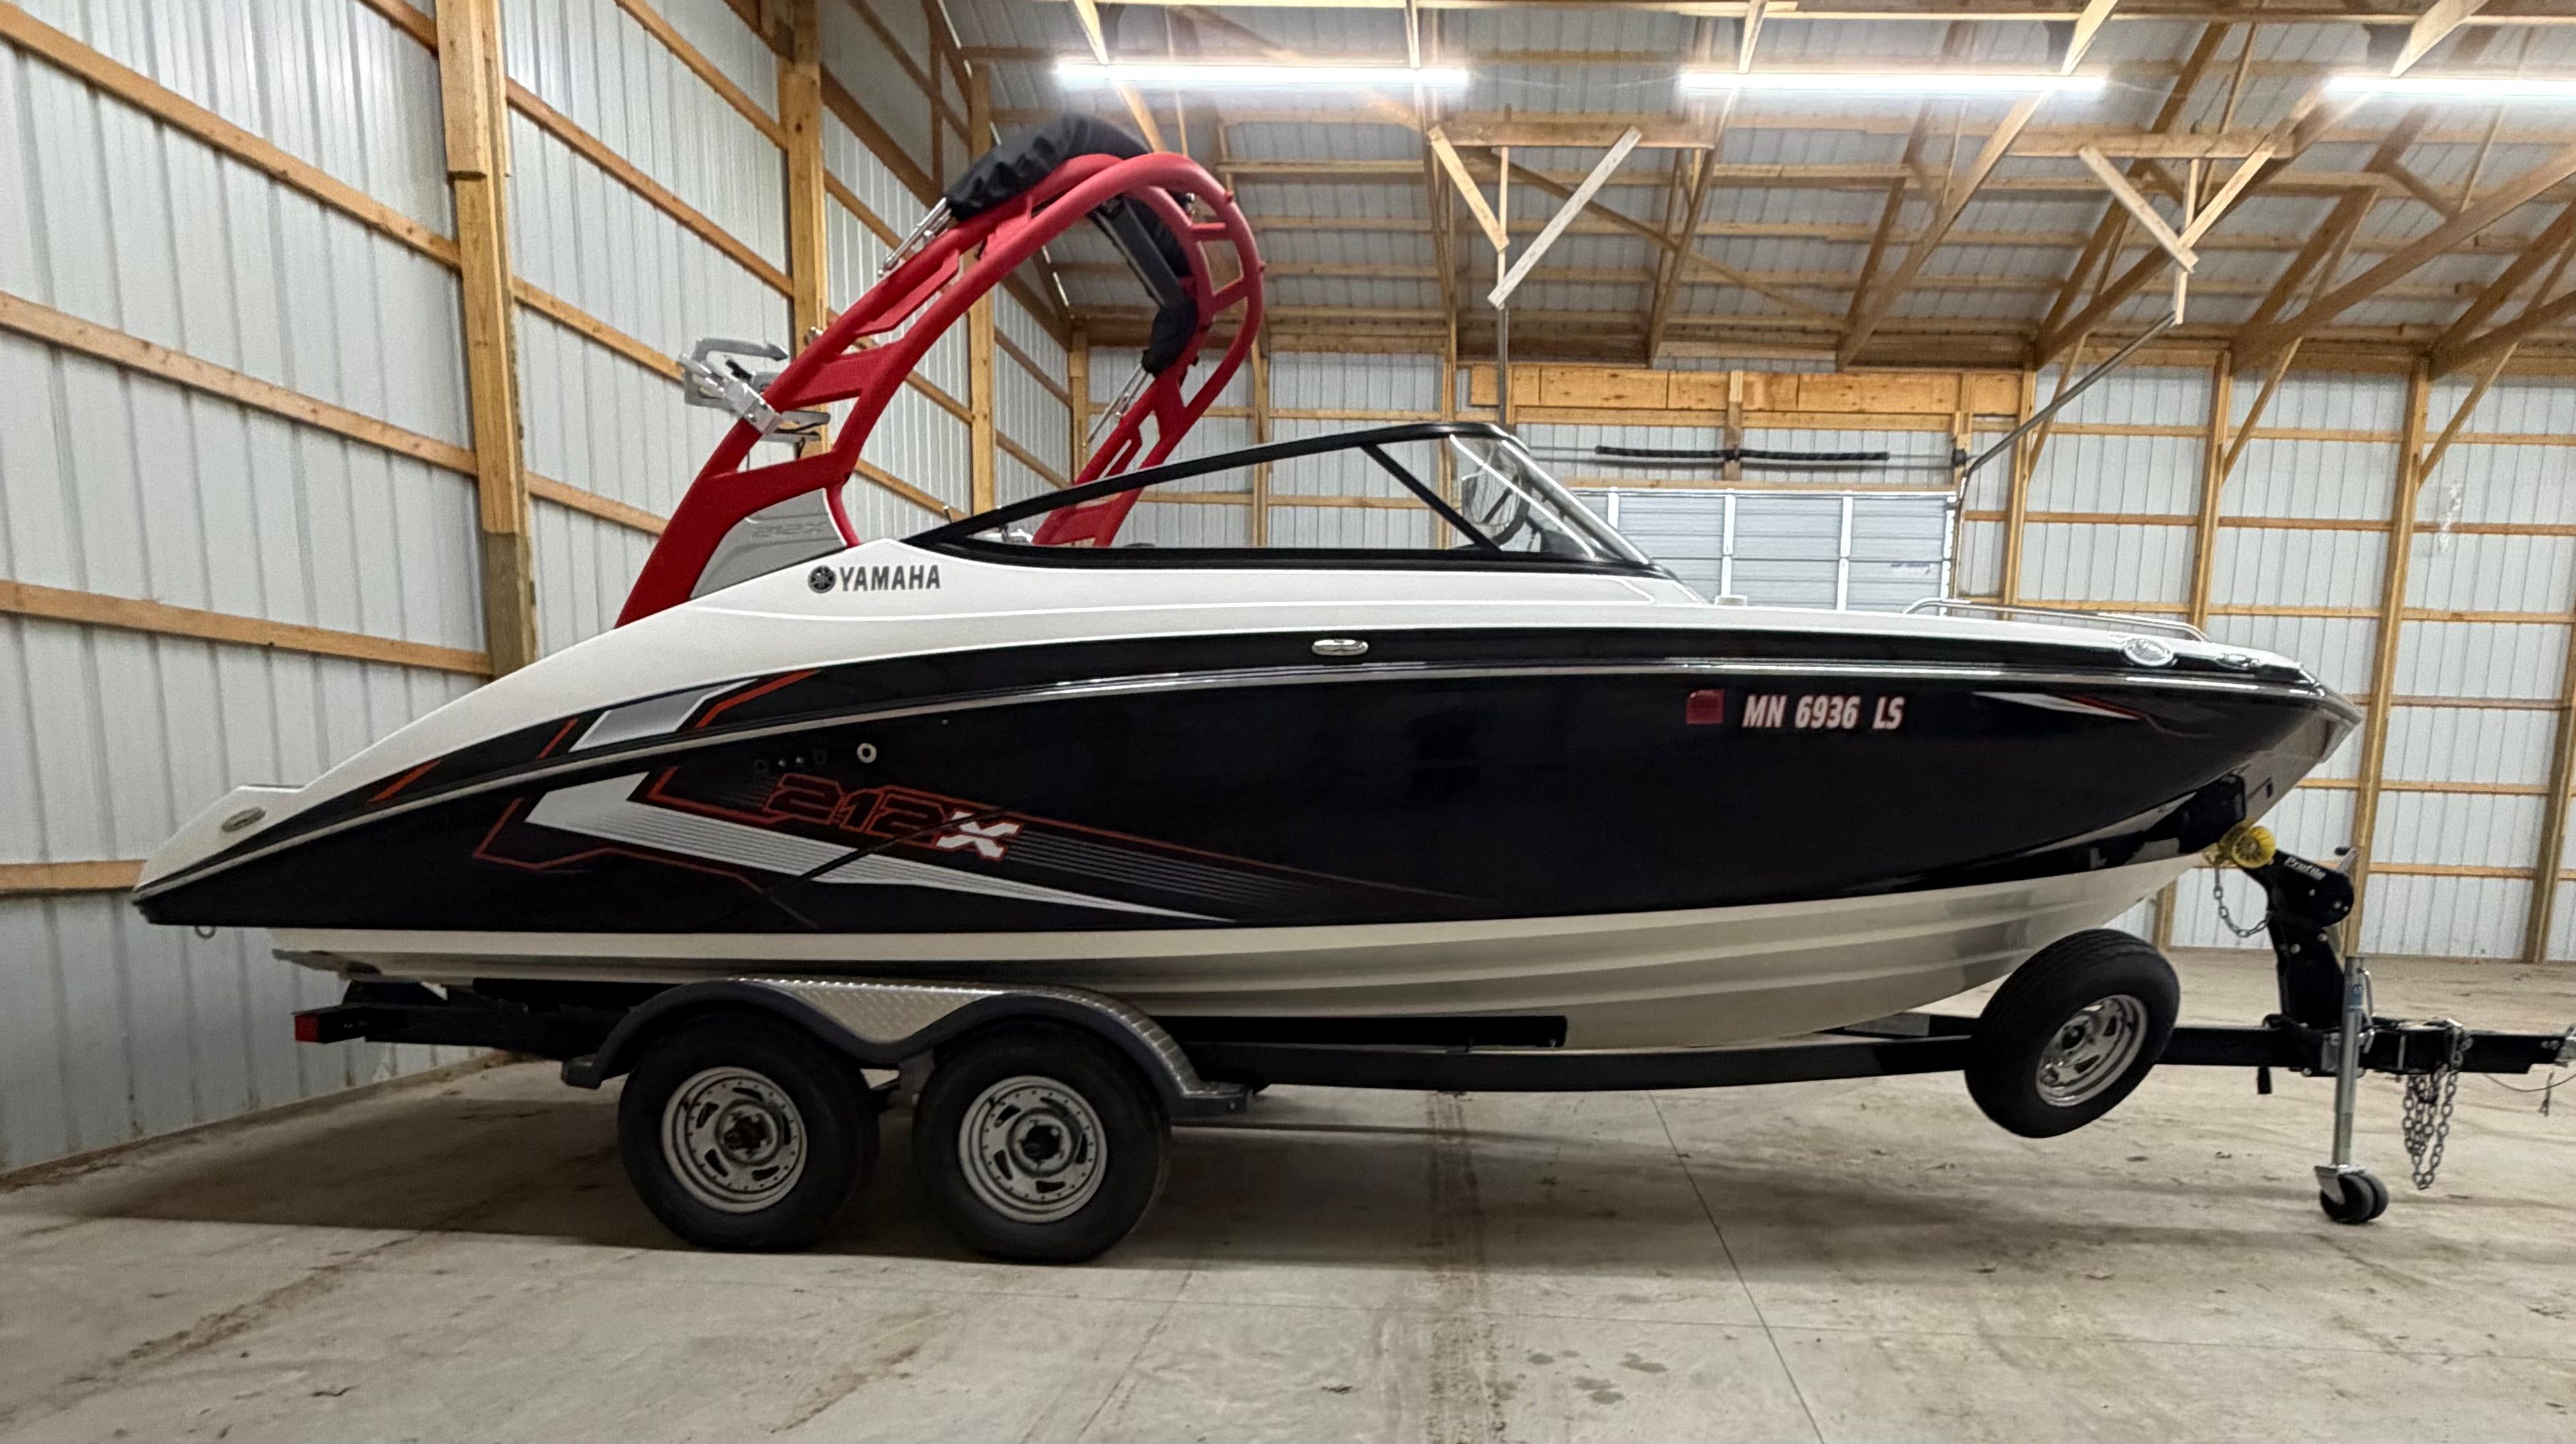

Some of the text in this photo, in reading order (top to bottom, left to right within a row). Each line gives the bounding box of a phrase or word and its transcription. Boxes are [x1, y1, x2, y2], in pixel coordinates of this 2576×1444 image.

[839, 565, 941, 592] YAMAHA
[1741, 695, 1906, 730] MN 6936 LS
[762, 773, 1023, 860] 212X
